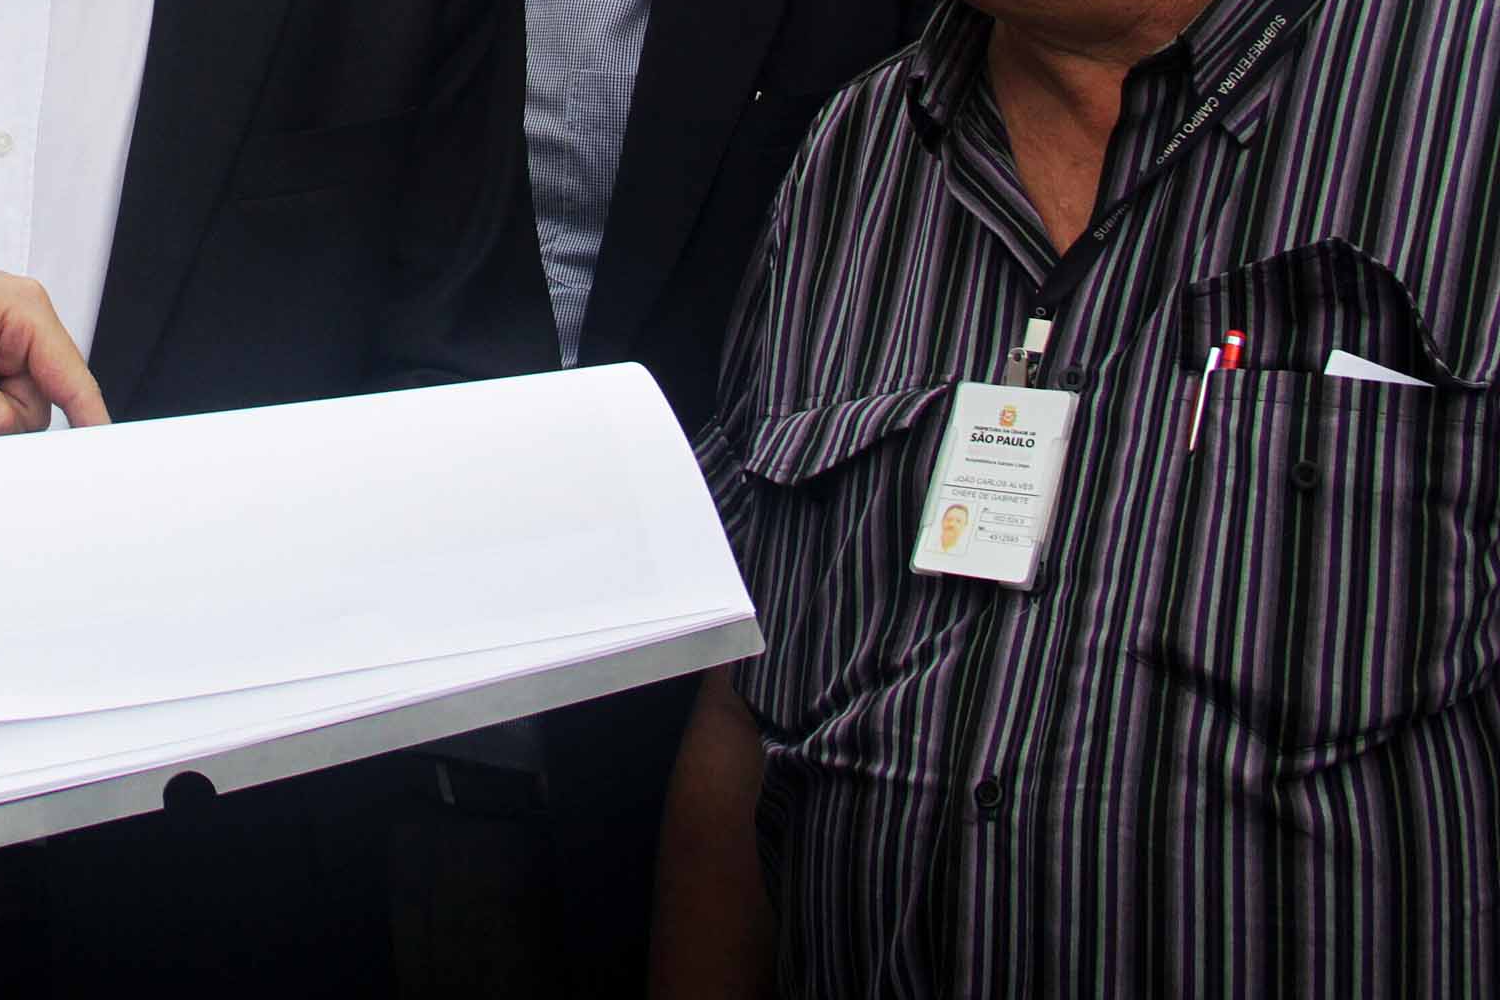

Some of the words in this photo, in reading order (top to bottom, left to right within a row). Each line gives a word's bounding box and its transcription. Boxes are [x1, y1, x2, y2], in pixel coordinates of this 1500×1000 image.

[1217, 14, 1288, 95] SUBPREFEITURA
[1182, 96, 1220, 134] CAMPO
[970, 431, 995, 444] SÃO
[995, 435, 1036, 449] PAULO
